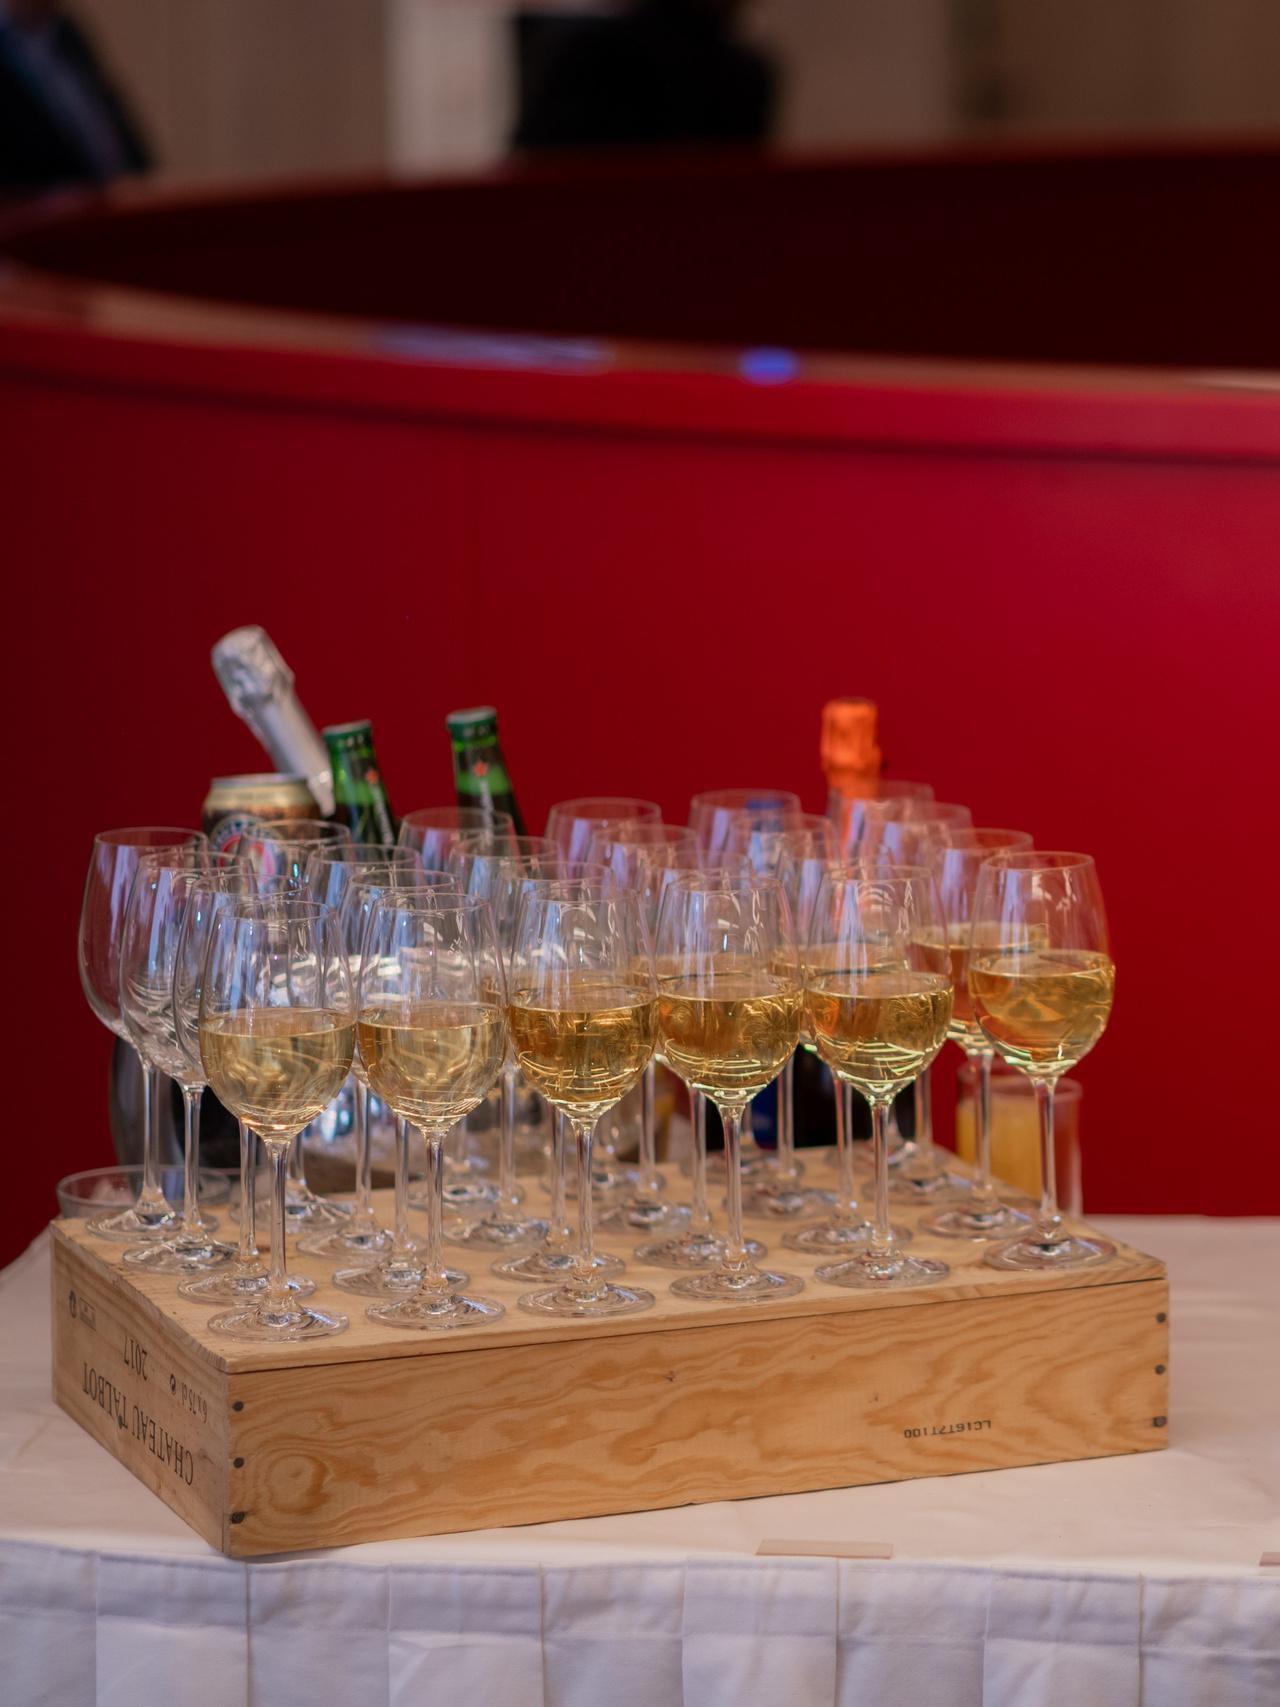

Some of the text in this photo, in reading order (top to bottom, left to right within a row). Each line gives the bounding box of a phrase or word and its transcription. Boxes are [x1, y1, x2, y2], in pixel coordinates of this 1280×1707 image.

[123, 1334, 148, 1382] 2017
[82, 1362, 194, 1486] CHATEAU TALBOT
